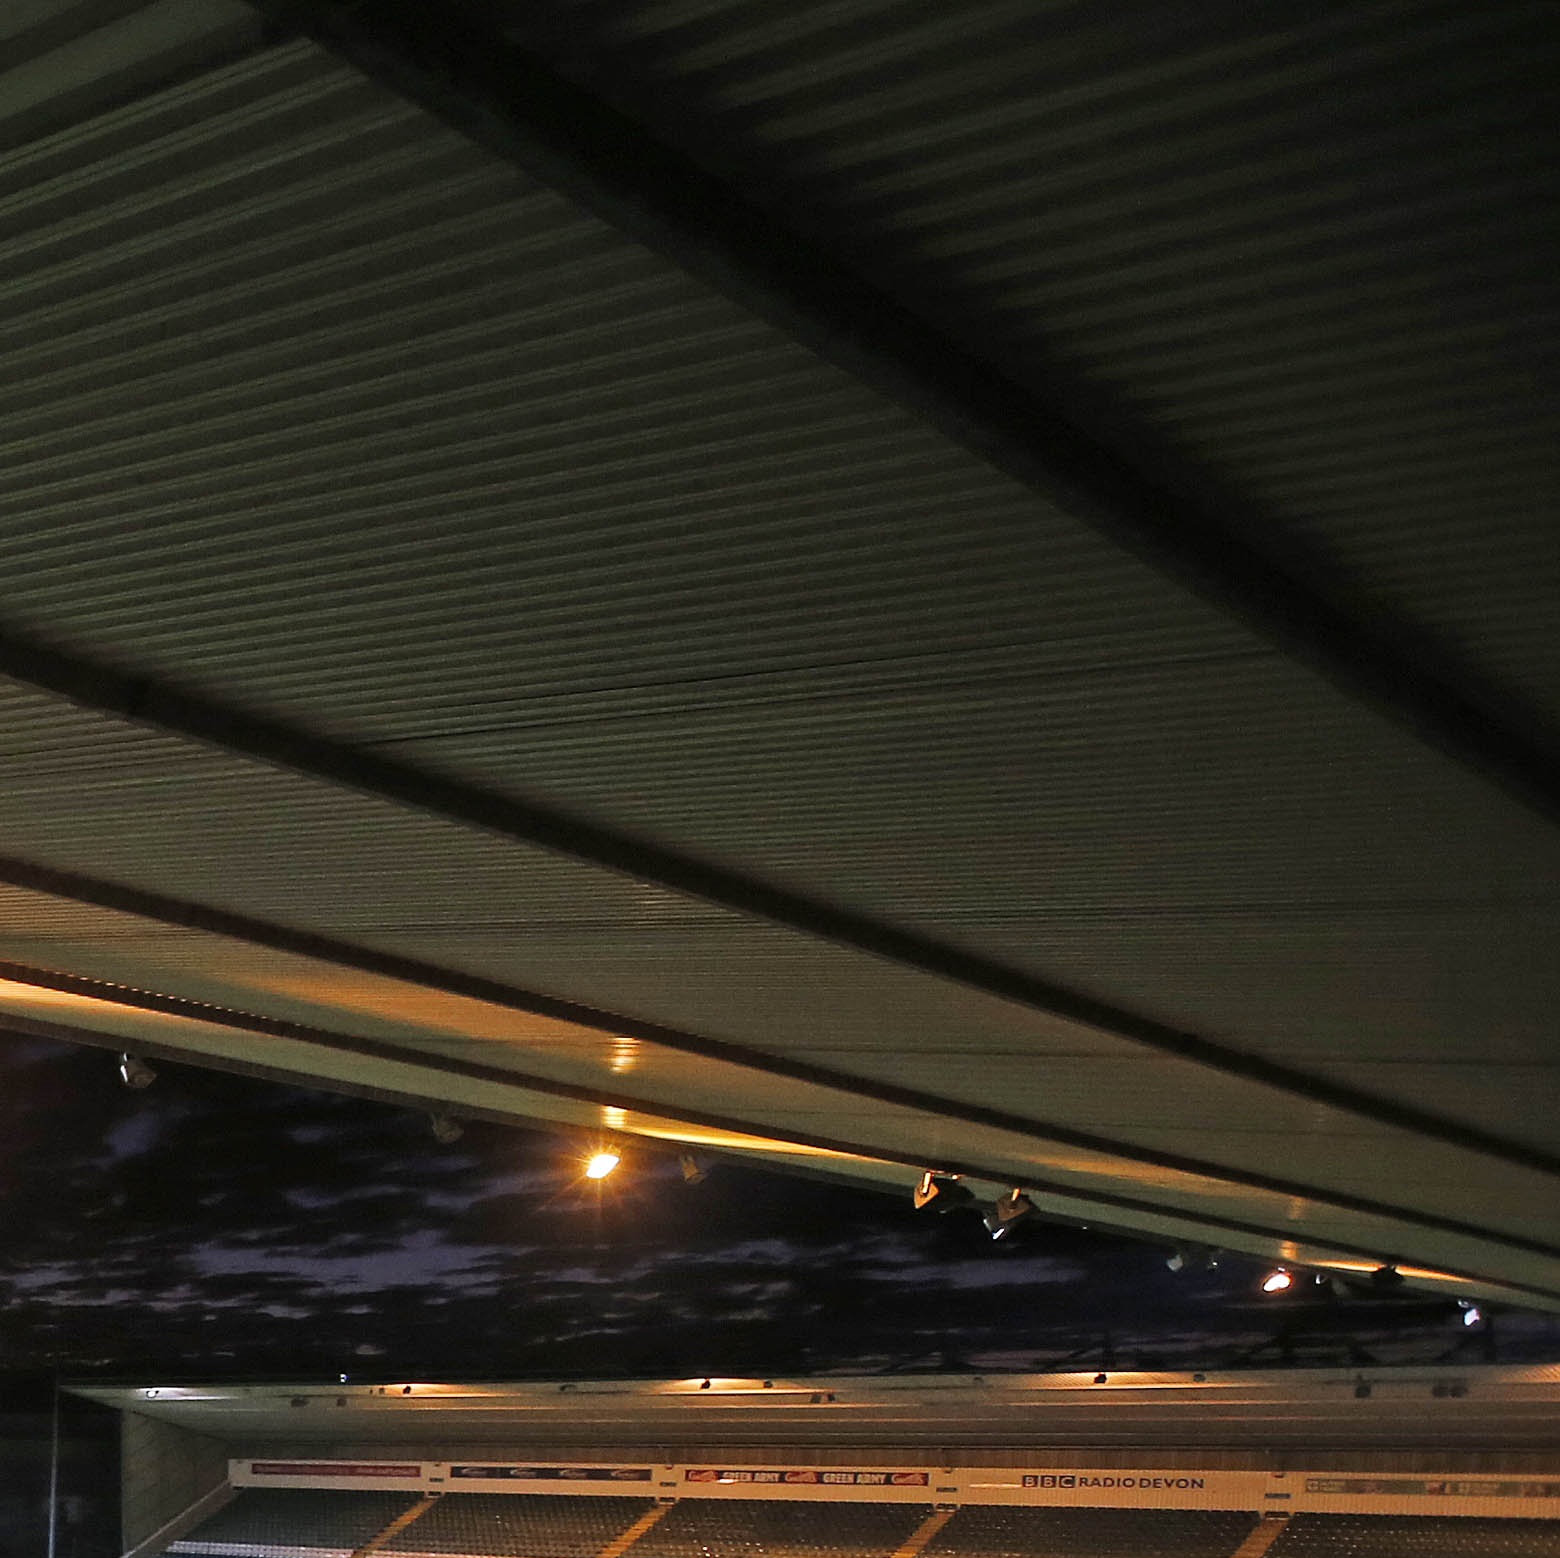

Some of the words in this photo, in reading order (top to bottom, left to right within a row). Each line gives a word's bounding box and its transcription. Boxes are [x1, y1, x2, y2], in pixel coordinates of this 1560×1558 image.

[1022, 1475, 1076, 1488] BBC
[1079, 1477, 1136, 1488] RADIO
[1139, 1478, 1205, 1489] DEVON
